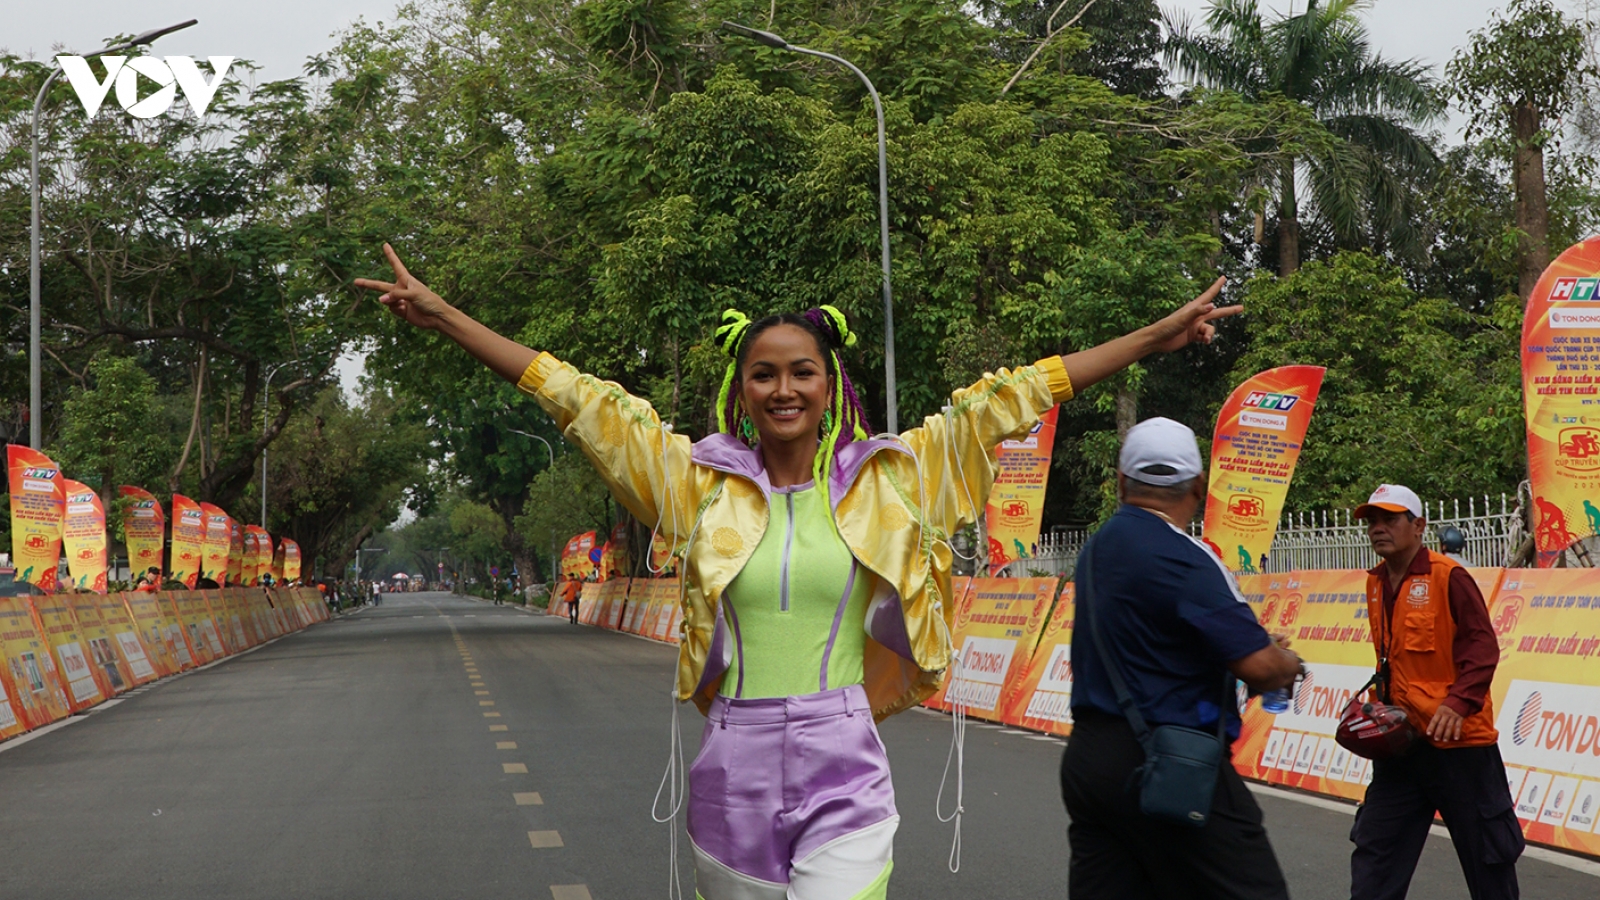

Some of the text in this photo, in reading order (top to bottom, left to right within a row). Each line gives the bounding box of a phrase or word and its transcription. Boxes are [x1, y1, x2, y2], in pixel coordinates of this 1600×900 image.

[1551, 280, 1600, 298] HT
[1244, 392, 1296, 410] HTV
[24, 468, 57, 478] HTV
[1530, 594, 1545, 610] CUỘC
[1298, 626, 1312, 640] NON
[1310, 624, 1326, 640] SÔNG
[1338, 625, 1354, 644] MỘT
[1517, 632, 1600, 660] NON SÔNG LIỀN MỘT
[1308, 686, 1341, 719] TON
[1534, 710, 1583, 752] TON
